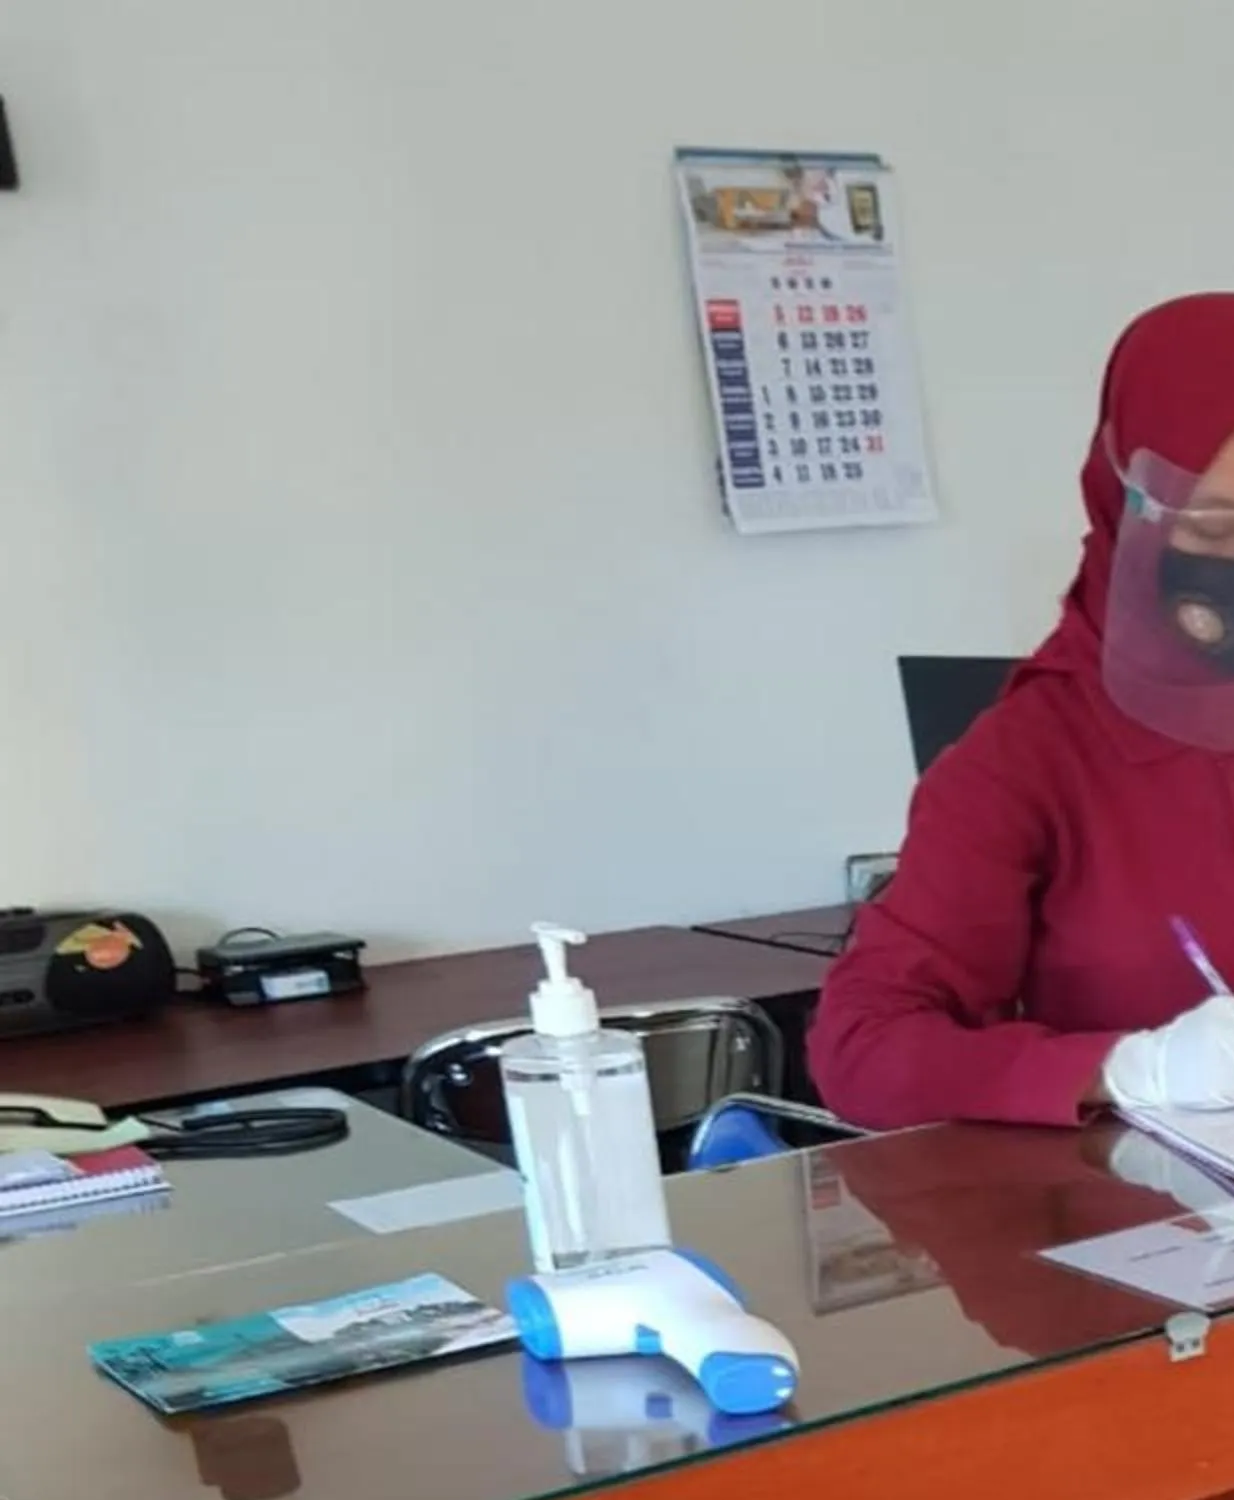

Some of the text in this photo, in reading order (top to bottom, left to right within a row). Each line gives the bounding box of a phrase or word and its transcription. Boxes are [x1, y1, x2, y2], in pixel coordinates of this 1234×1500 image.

[848, 331, 869, 349] 27
[805, 358, 821, 376] 14
[829, 357, 848, 375] 21
[831, 384, 852, 401] 22
[835, 409, 857, 427] 23
[839, 435, 860, 453] 24
